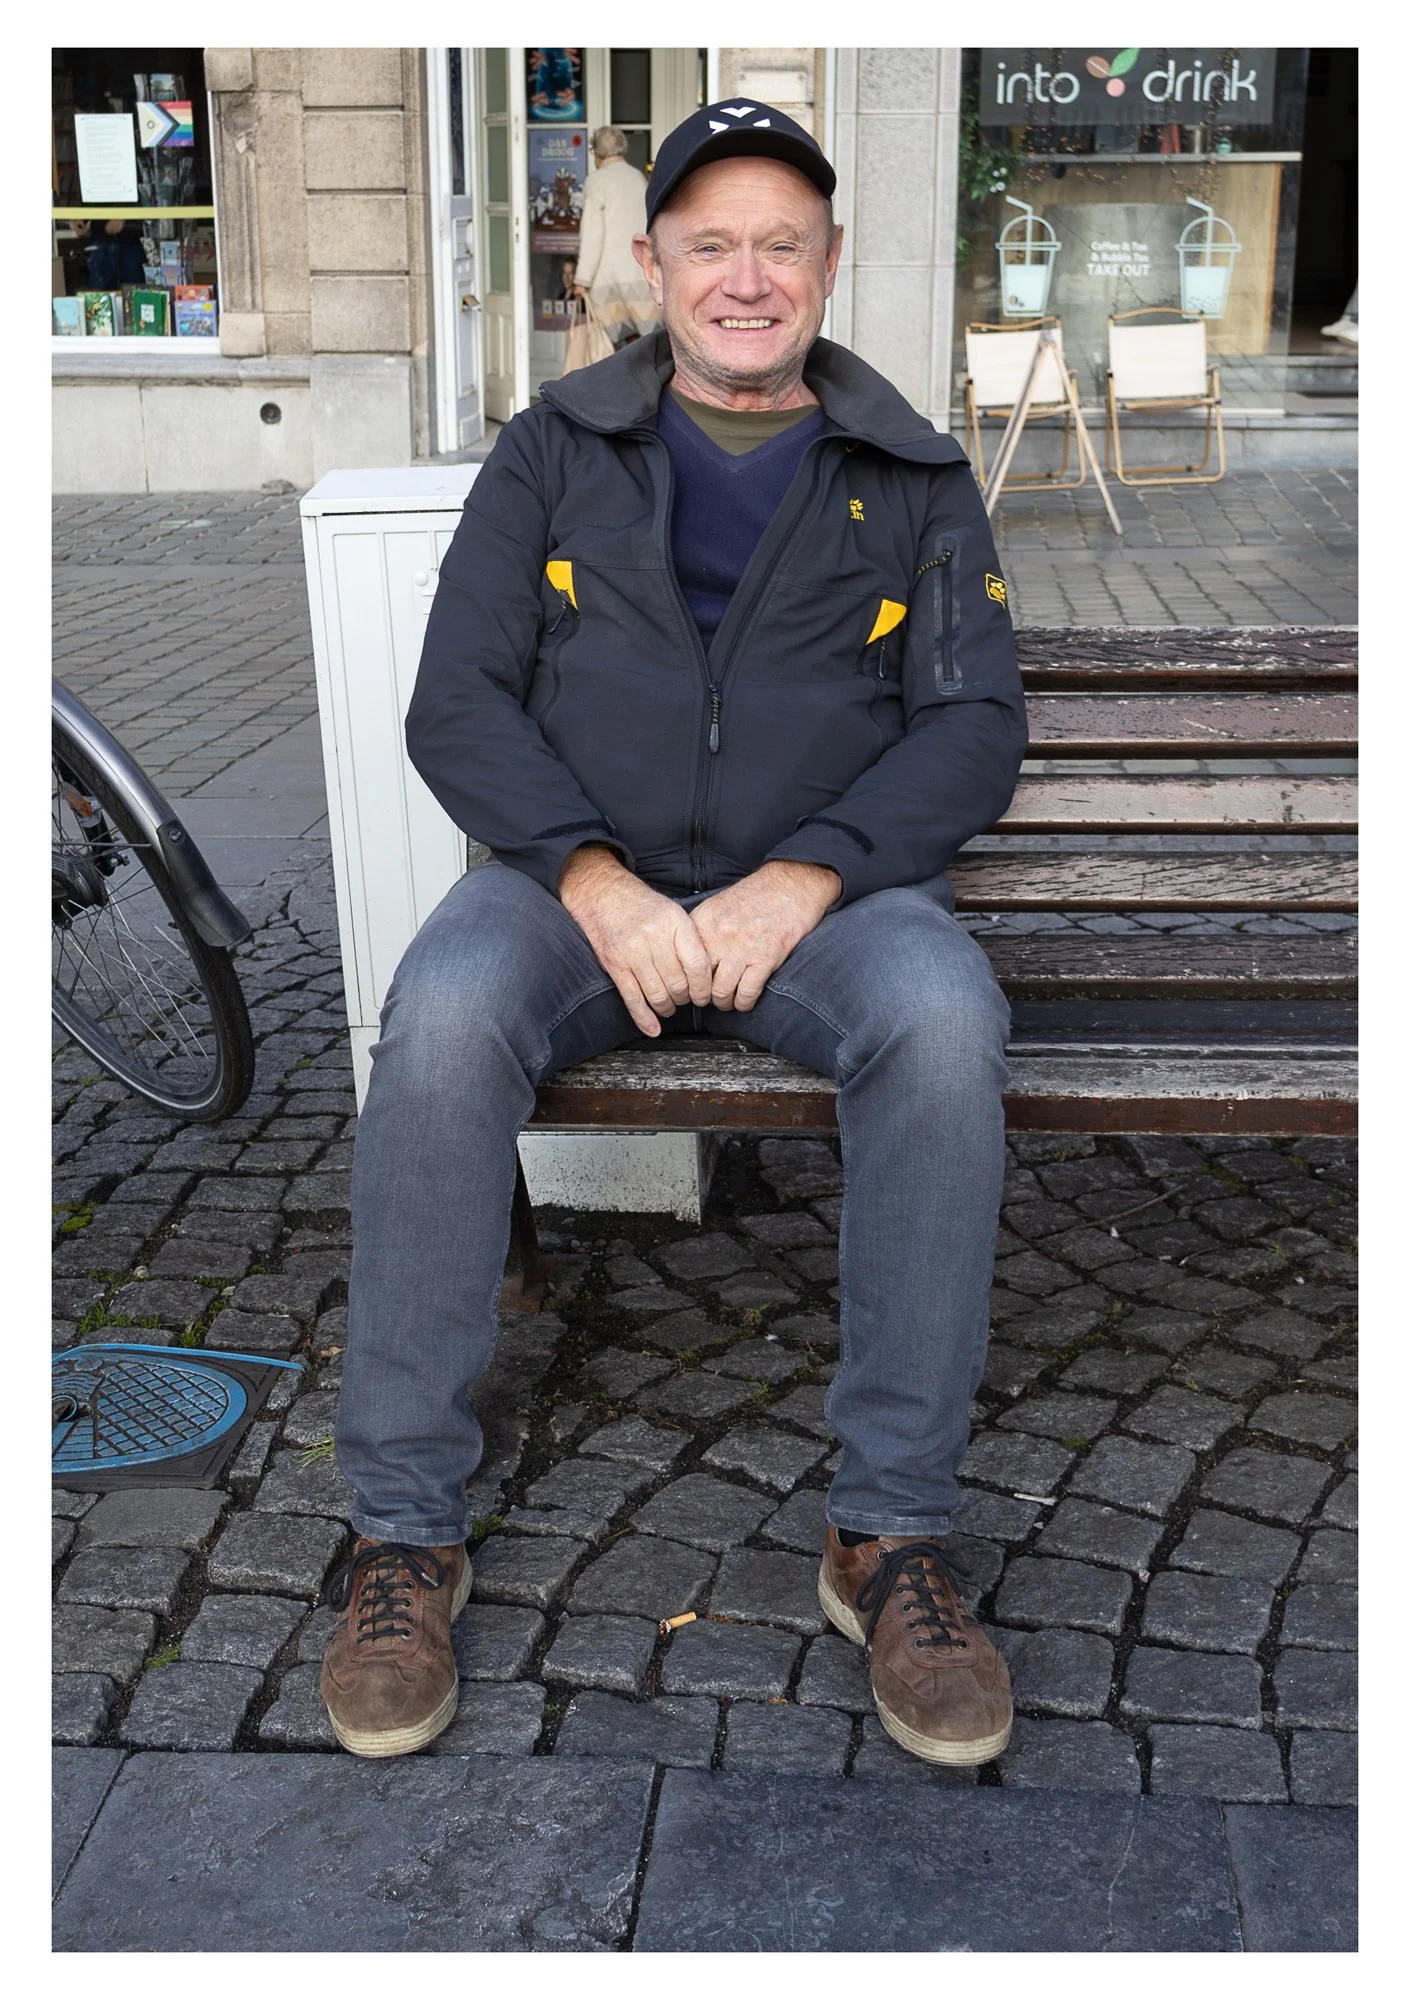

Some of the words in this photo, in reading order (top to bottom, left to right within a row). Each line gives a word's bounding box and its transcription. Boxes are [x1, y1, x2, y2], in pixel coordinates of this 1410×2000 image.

[996, 62, 1080, 104] into
[1142, 59, 1257, 103] drink
[1086, 263, 1120, 277] TAKE
[1121, 263, 1150, 277] OUT
